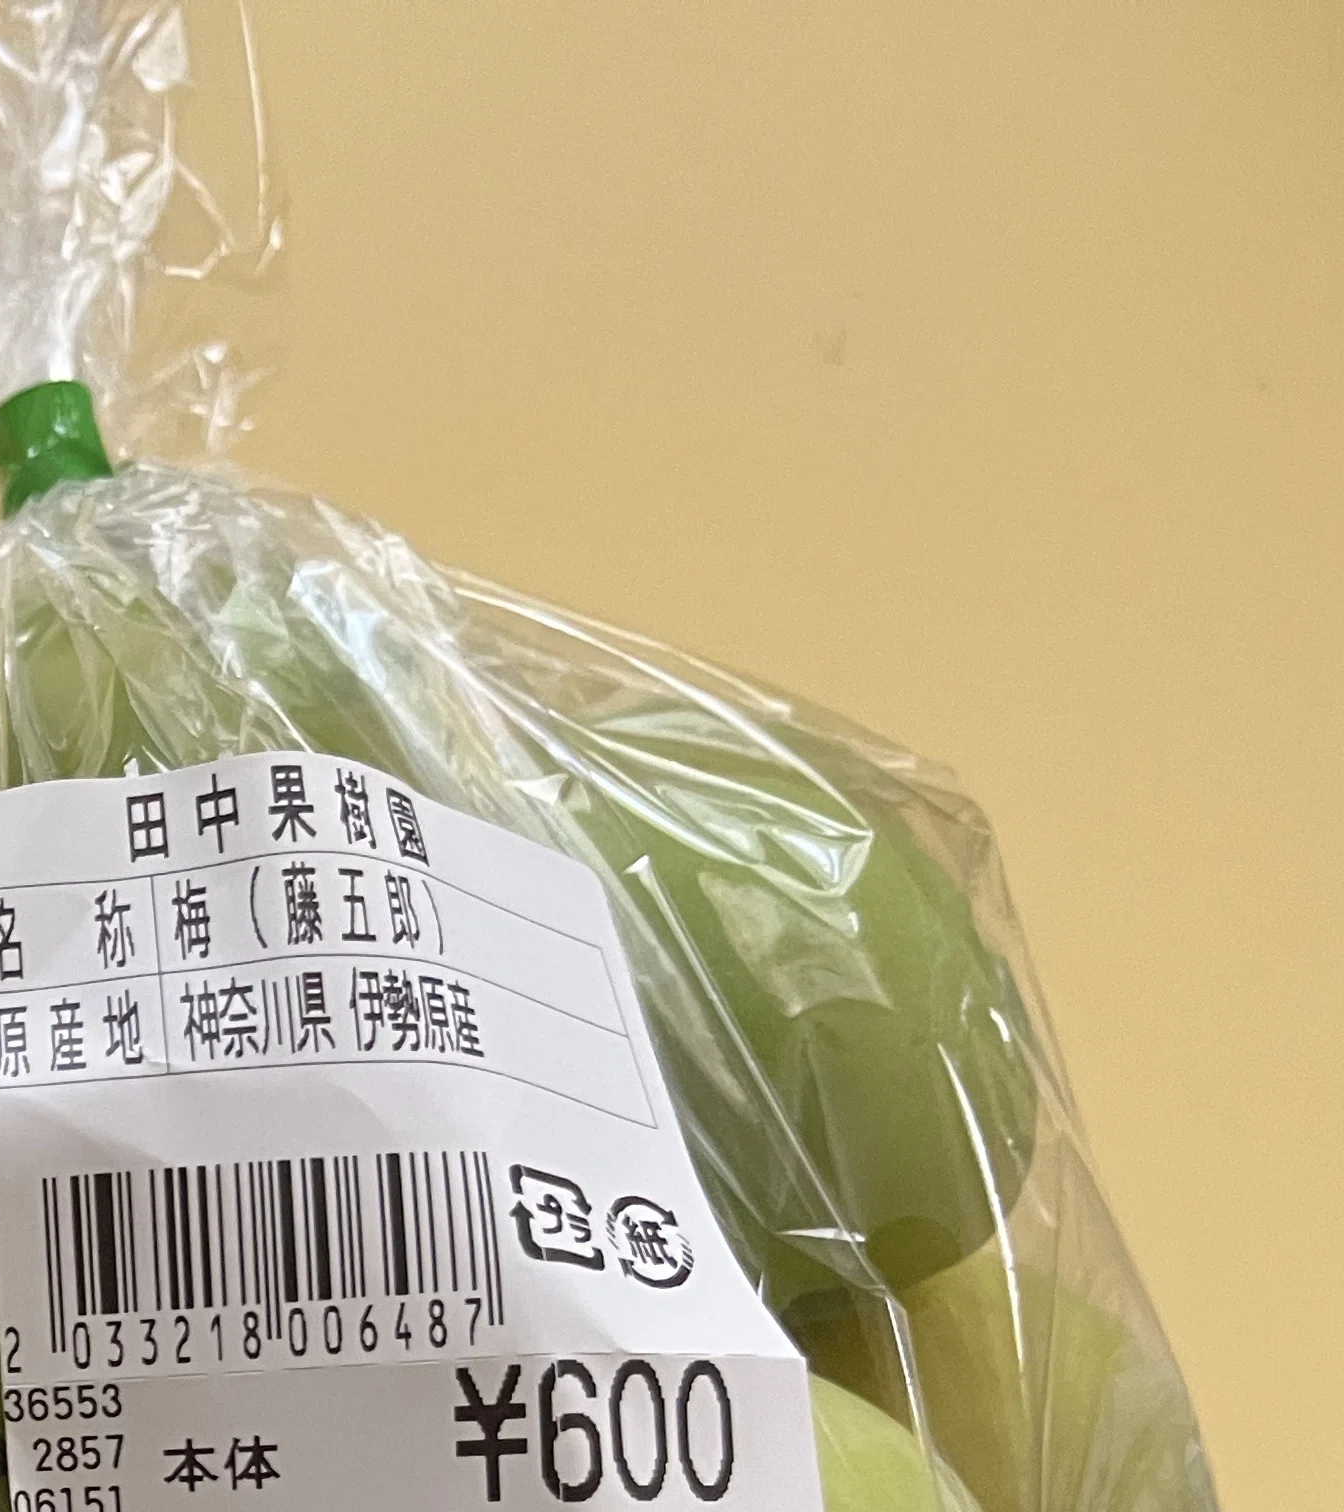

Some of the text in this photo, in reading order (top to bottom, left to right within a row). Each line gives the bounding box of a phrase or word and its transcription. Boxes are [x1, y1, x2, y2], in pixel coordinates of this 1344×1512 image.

[126, 764, 430, 868] 田中果樹園
[180, 971, 336, 1061] 神奈川県
[349, 966, 485, 1059] 伊勢原産
[4, 1384, 123, 1423] 36553
[162, 1358, 734, 1502] 本体 ¥600
[33, 1434, 124, 1472] 2857
